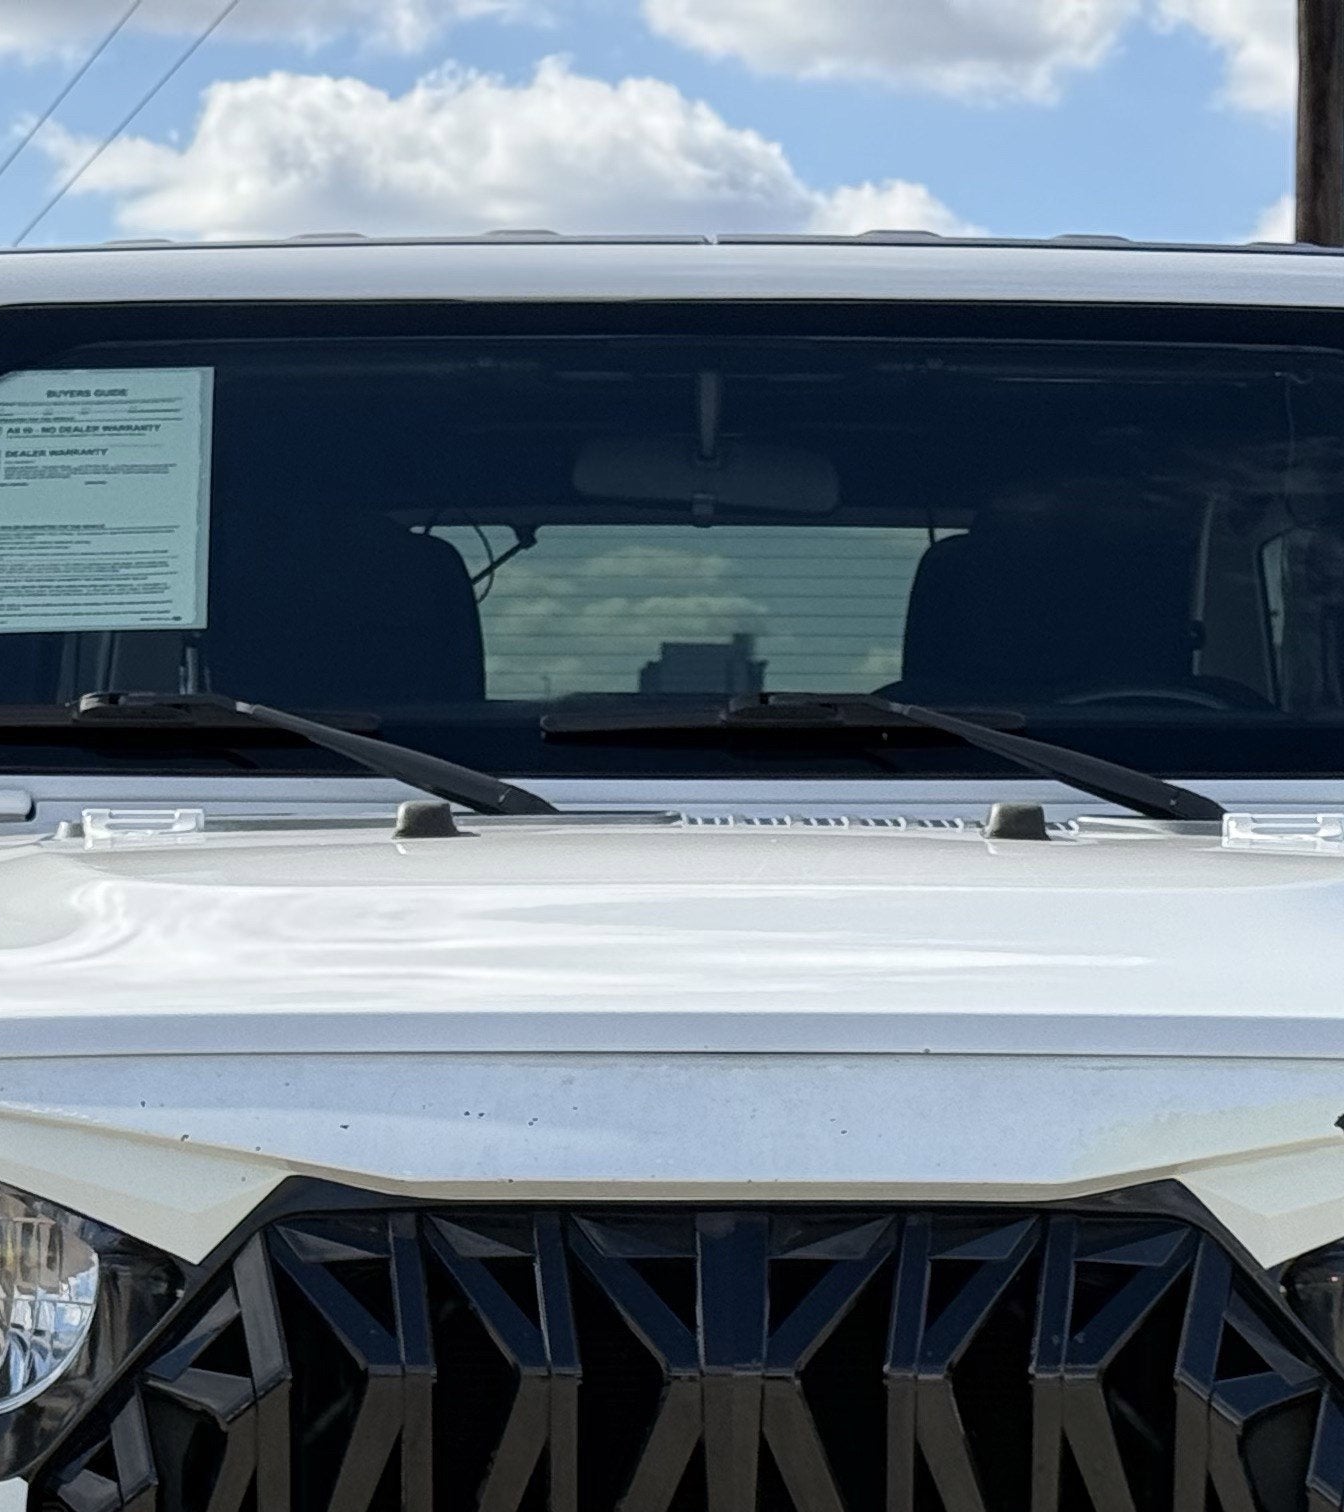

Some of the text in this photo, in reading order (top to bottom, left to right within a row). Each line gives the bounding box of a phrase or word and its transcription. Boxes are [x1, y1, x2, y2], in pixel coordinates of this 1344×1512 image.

[46, 388, 128, 398] BUYERS GUIDE
[58, 425, 100, 433] DEALER
[102, 424, 161, 432] WARRANTY
[4, 448, 108, 458] DEALER WARRANTY
